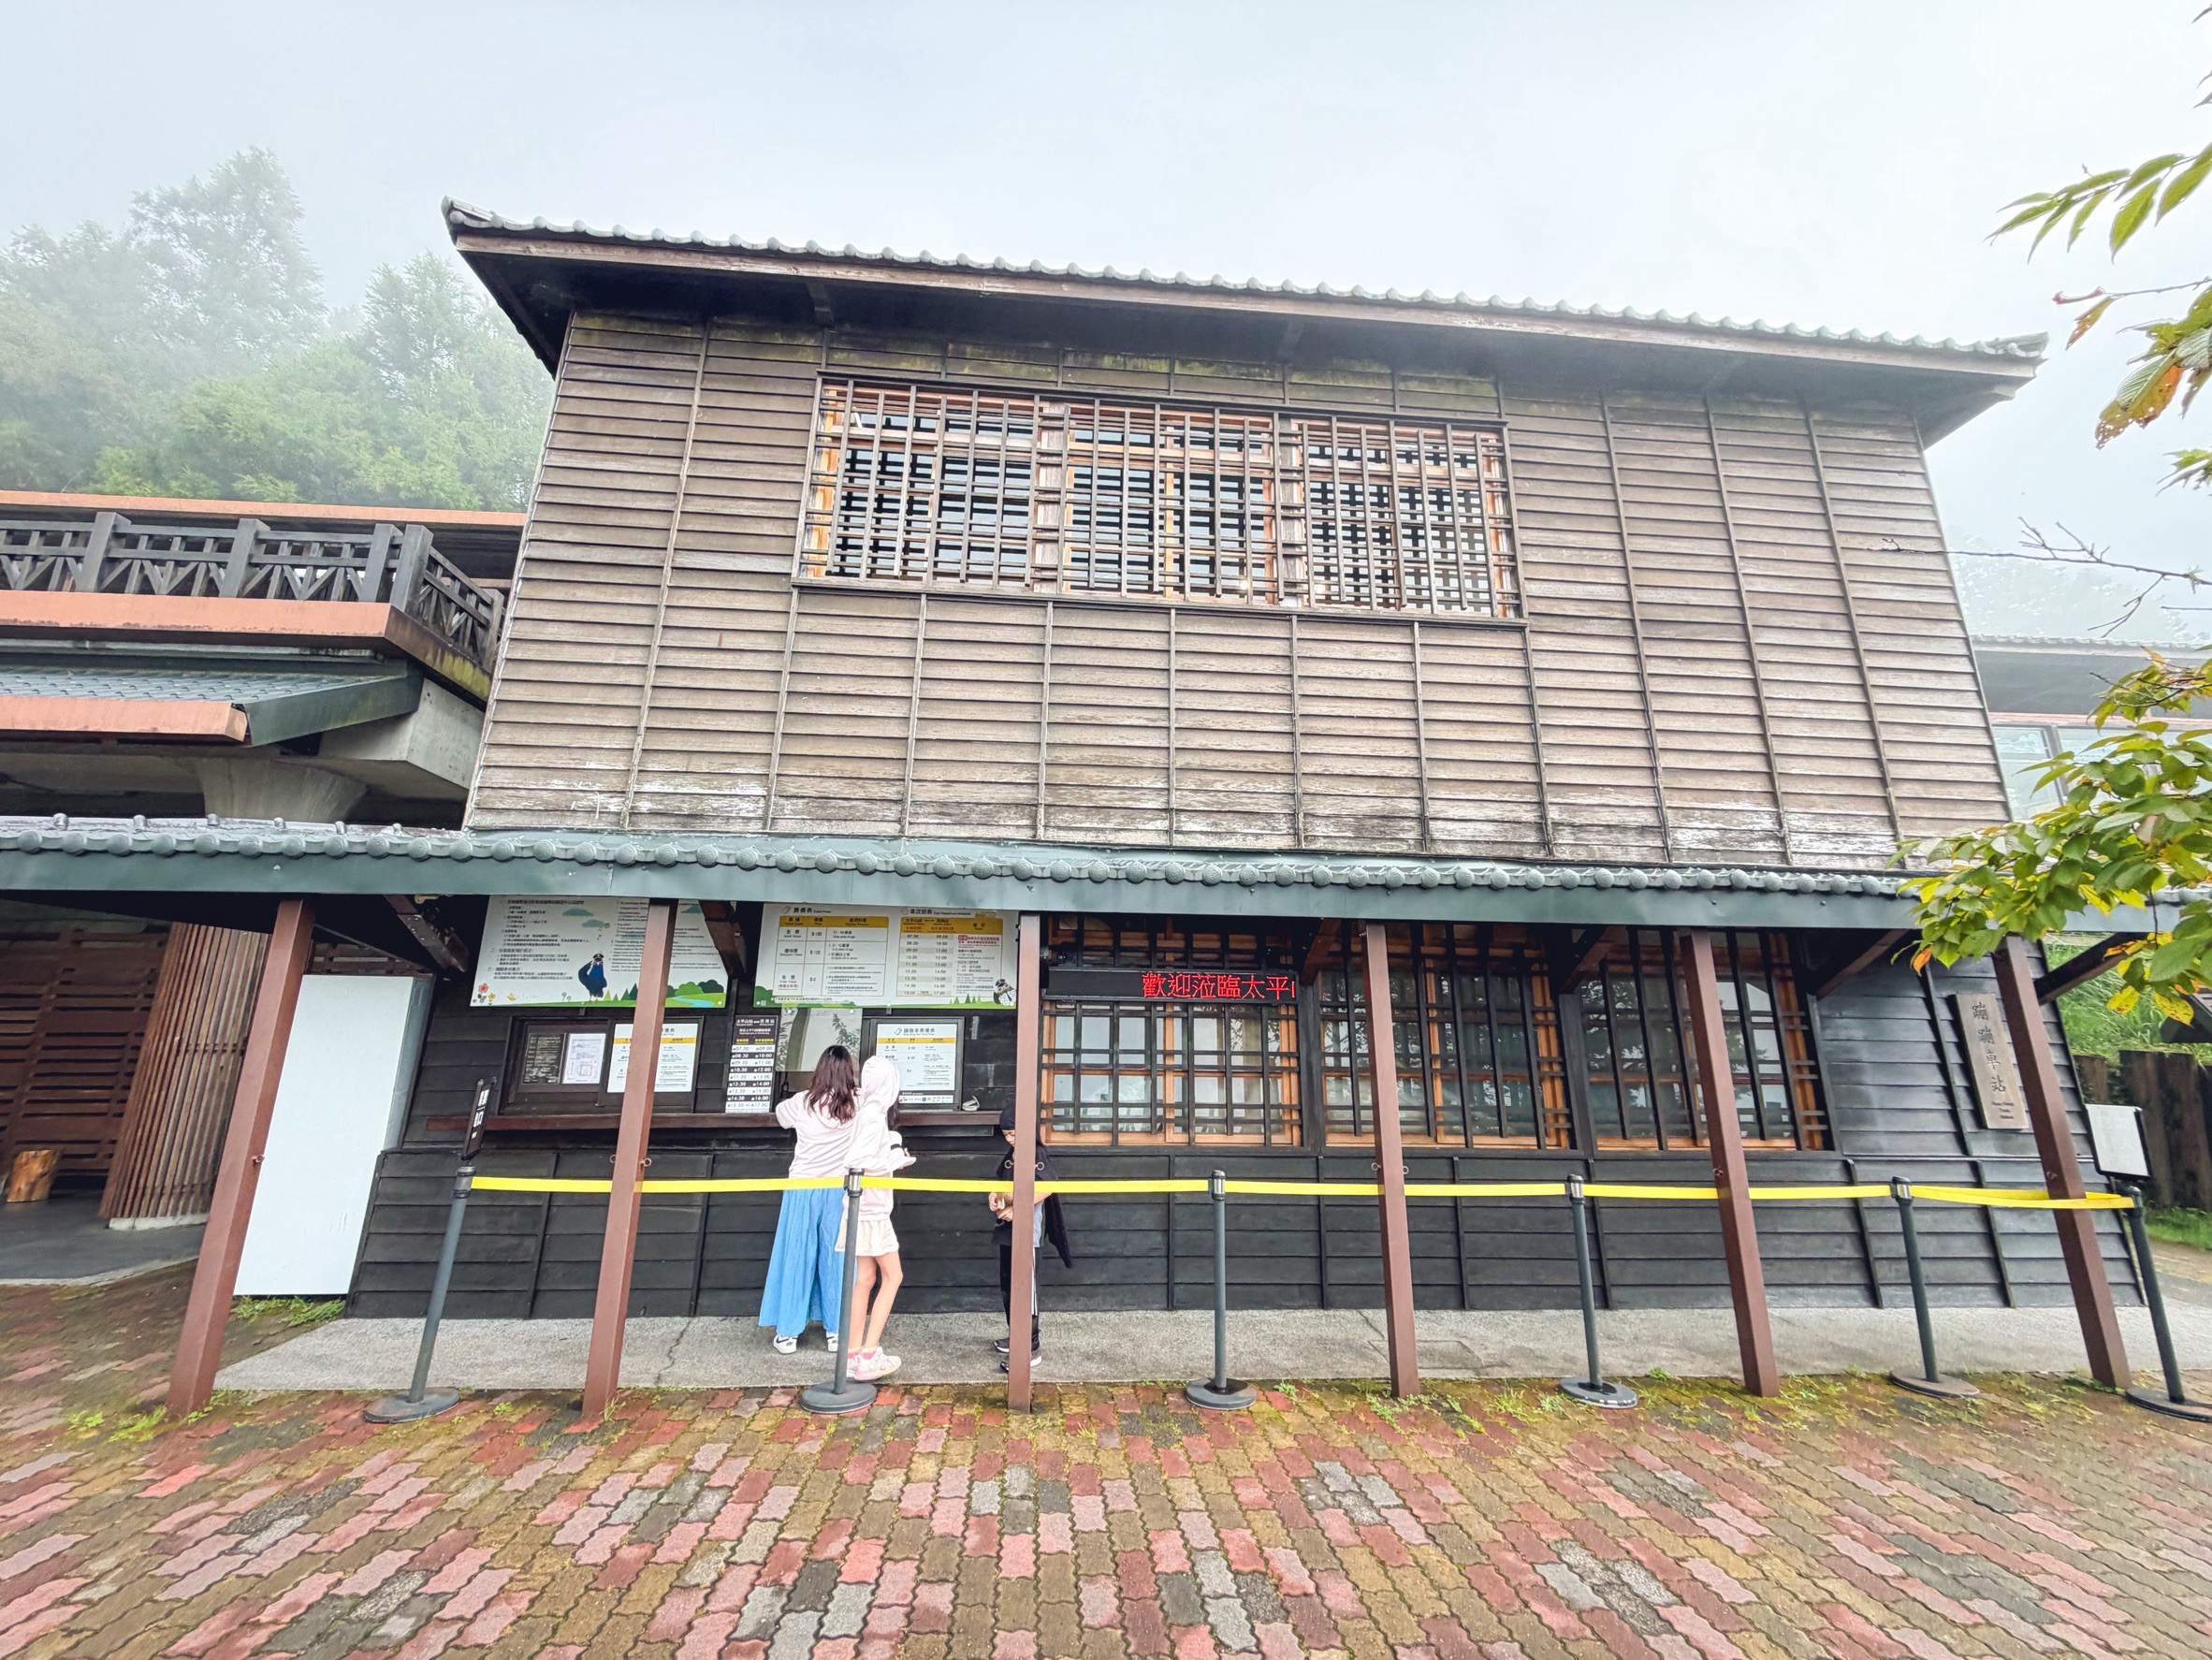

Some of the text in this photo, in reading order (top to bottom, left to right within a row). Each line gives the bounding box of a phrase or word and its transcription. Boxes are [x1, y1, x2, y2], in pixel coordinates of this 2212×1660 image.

[1142, 973, 1295, 1000] 歡迎蒞臨太平
[1972, 1002, 2006, 1093] 蹦蹦車站
